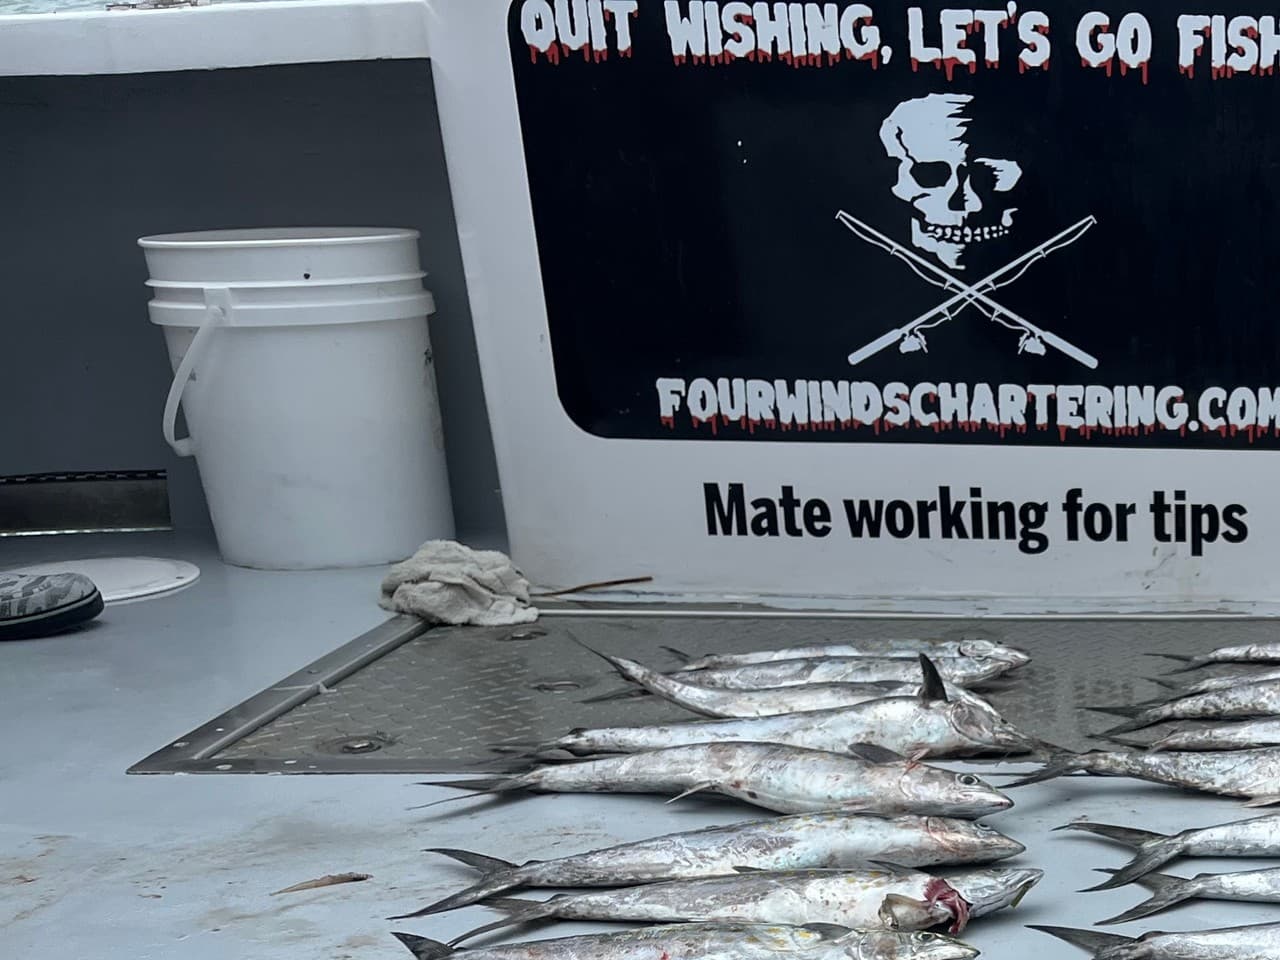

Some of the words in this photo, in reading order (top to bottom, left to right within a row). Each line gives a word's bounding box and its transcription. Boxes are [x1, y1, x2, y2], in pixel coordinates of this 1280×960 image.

[521, 0, 638, 62] QUIT
[664, 1, 892, 66] WISHING,
[907, 1, 1051, 76] LET'S
[1076, 11, 1152, 79] GO
[702, 482, 833, 538] Mate
[843, 485, 1050, 555] working
[1063, 488, 1137, 542] for
[1150, 490, 1249, 557] tips
